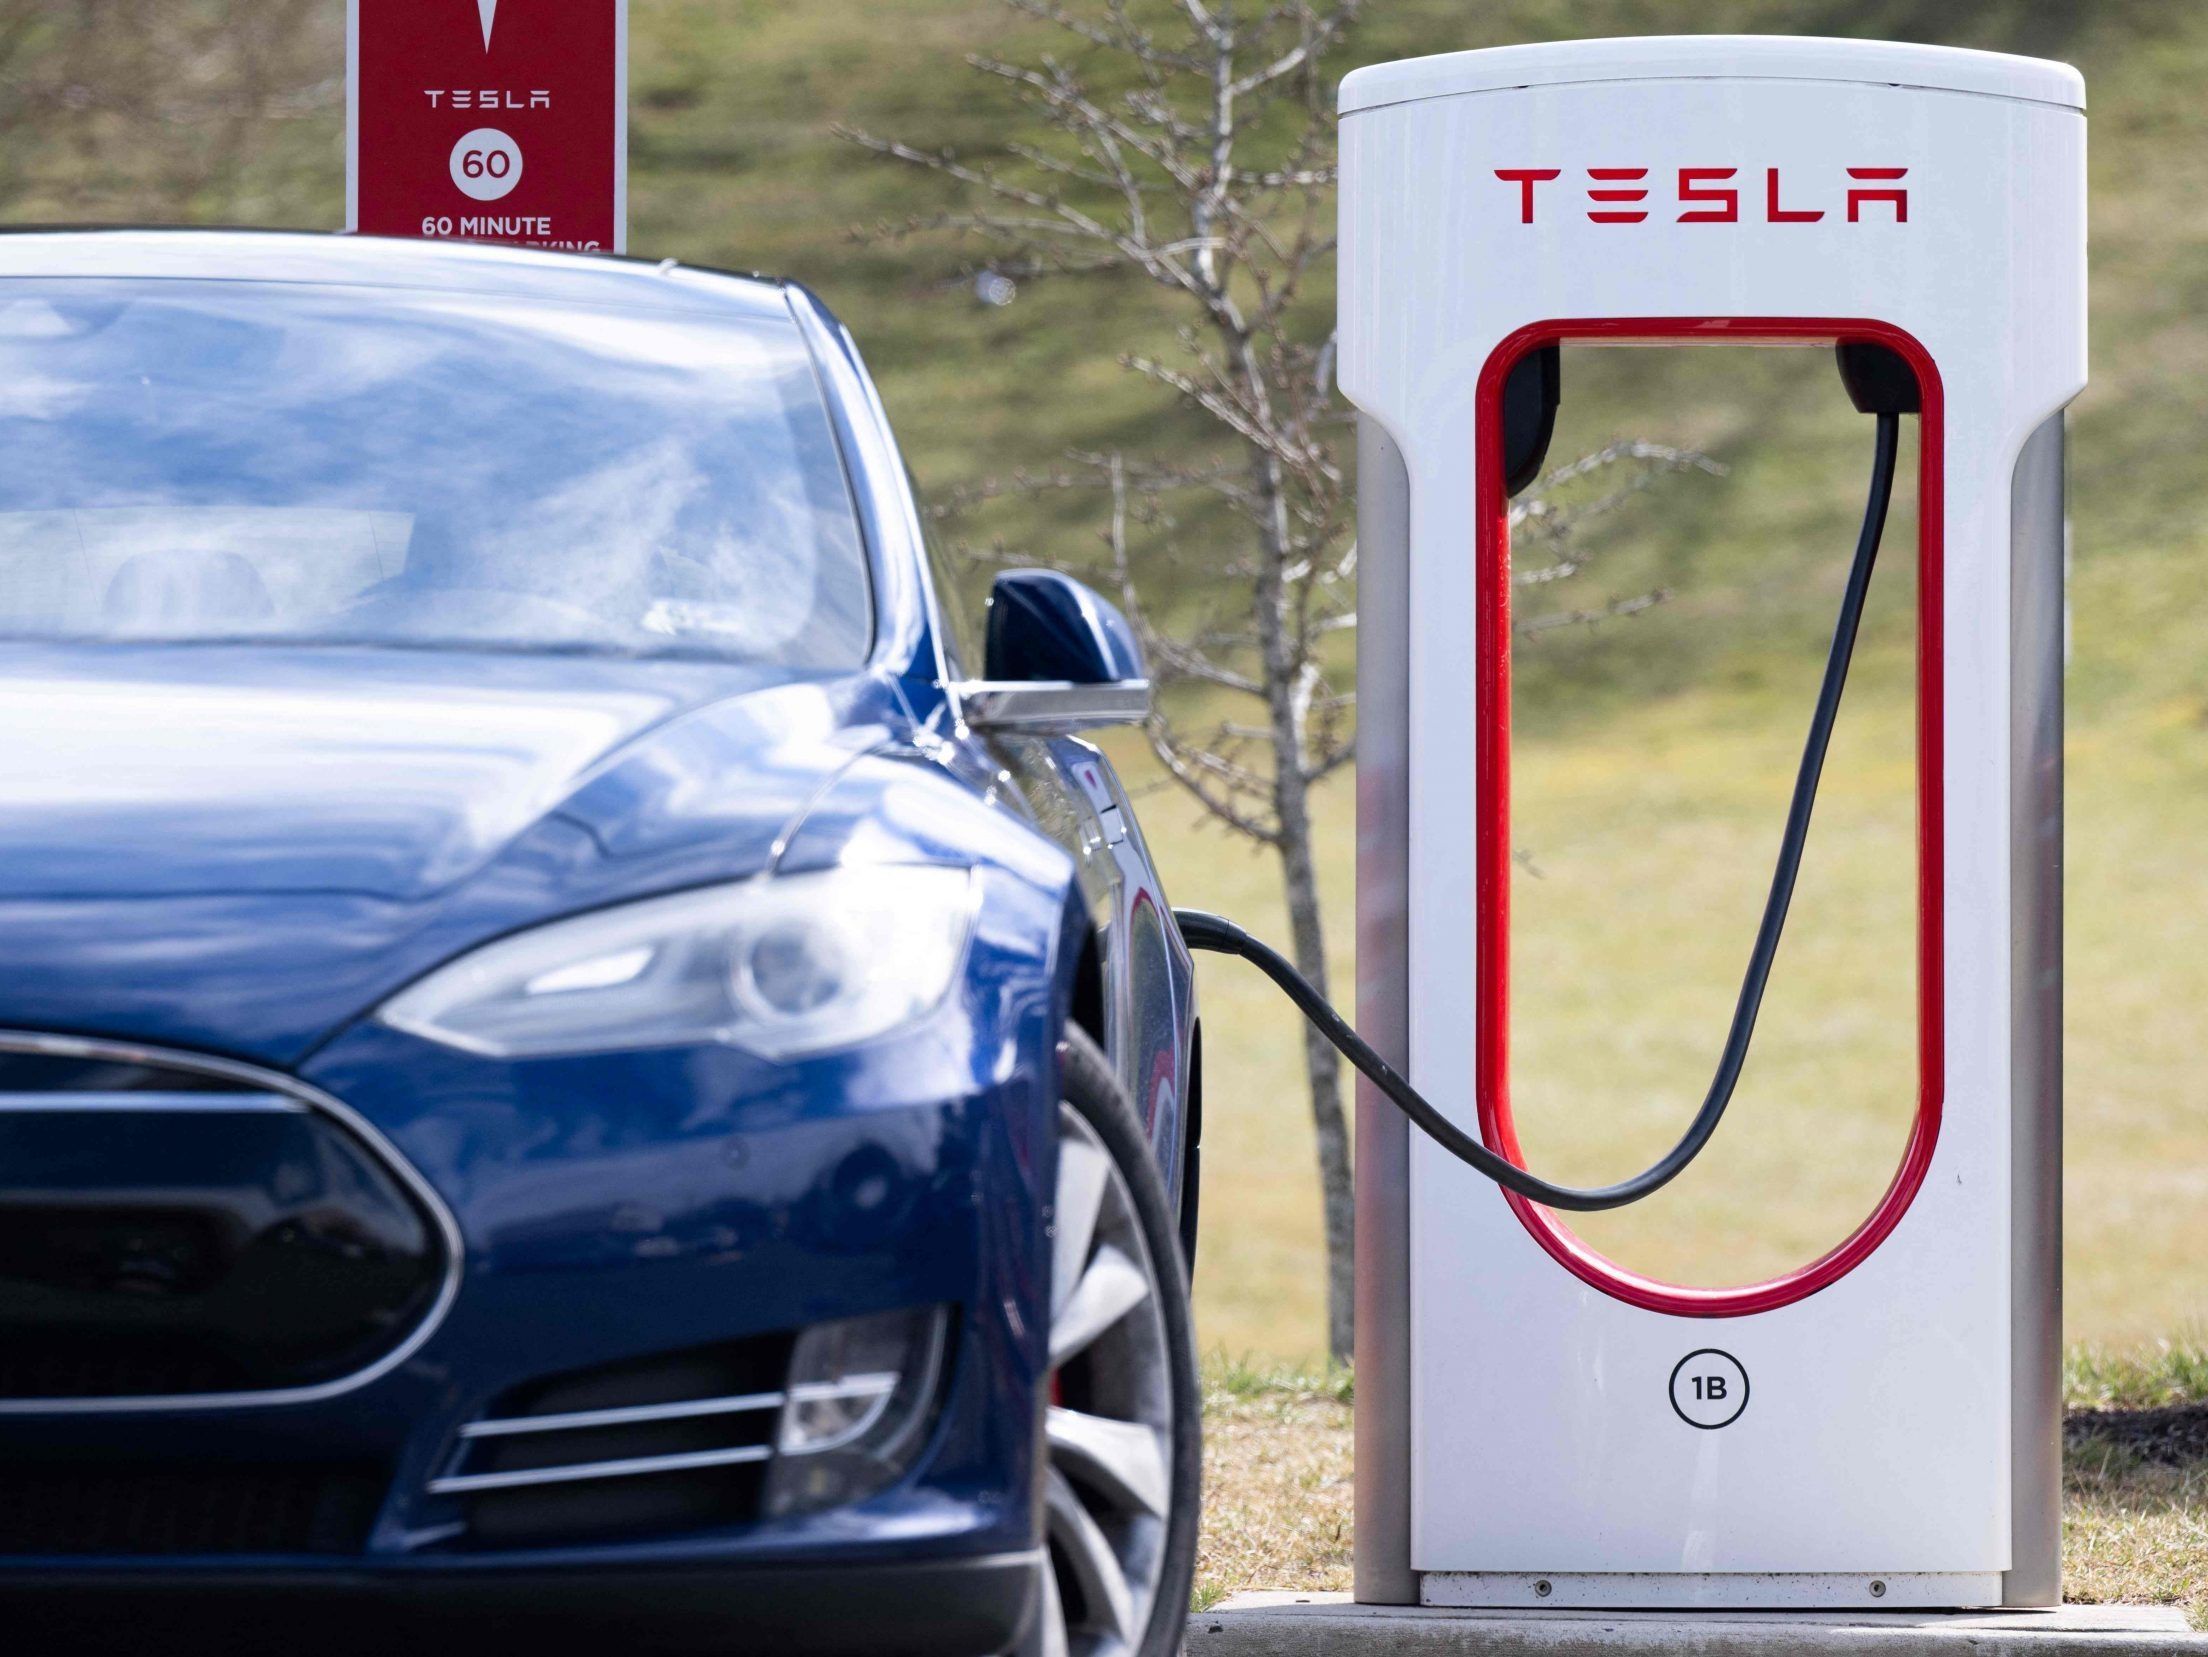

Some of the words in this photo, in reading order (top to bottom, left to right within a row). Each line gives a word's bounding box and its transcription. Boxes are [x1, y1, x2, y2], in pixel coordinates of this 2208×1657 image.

[423, 90, 550, 109] TESLA
[462, 149, 511, 179] 60
[1493, 167, 1909, 224] TESLA
[421, 216, 453, 235] 60
[460, 216, 551, 236] MINUTE
[1691, 1376, 1728, 1400] 1B
